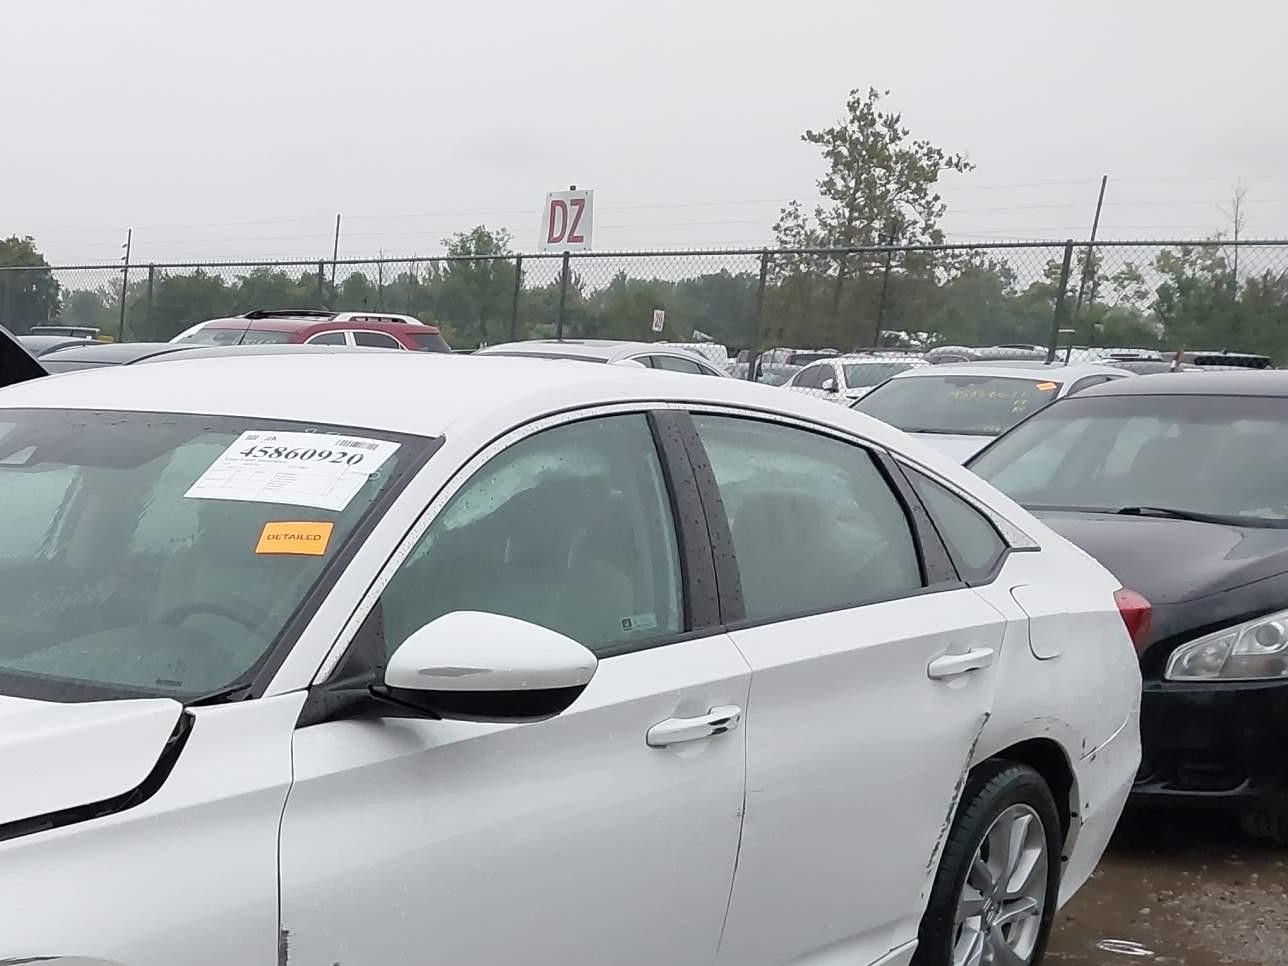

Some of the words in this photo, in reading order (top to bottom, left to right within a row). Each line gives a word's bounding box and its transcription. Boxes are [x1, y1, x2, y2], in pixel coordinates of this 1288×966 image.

[547, 198, 585, 244] DZ
[240, 445, 364, 465] 45860920
[266, 533, 322, 541] DETAILED
